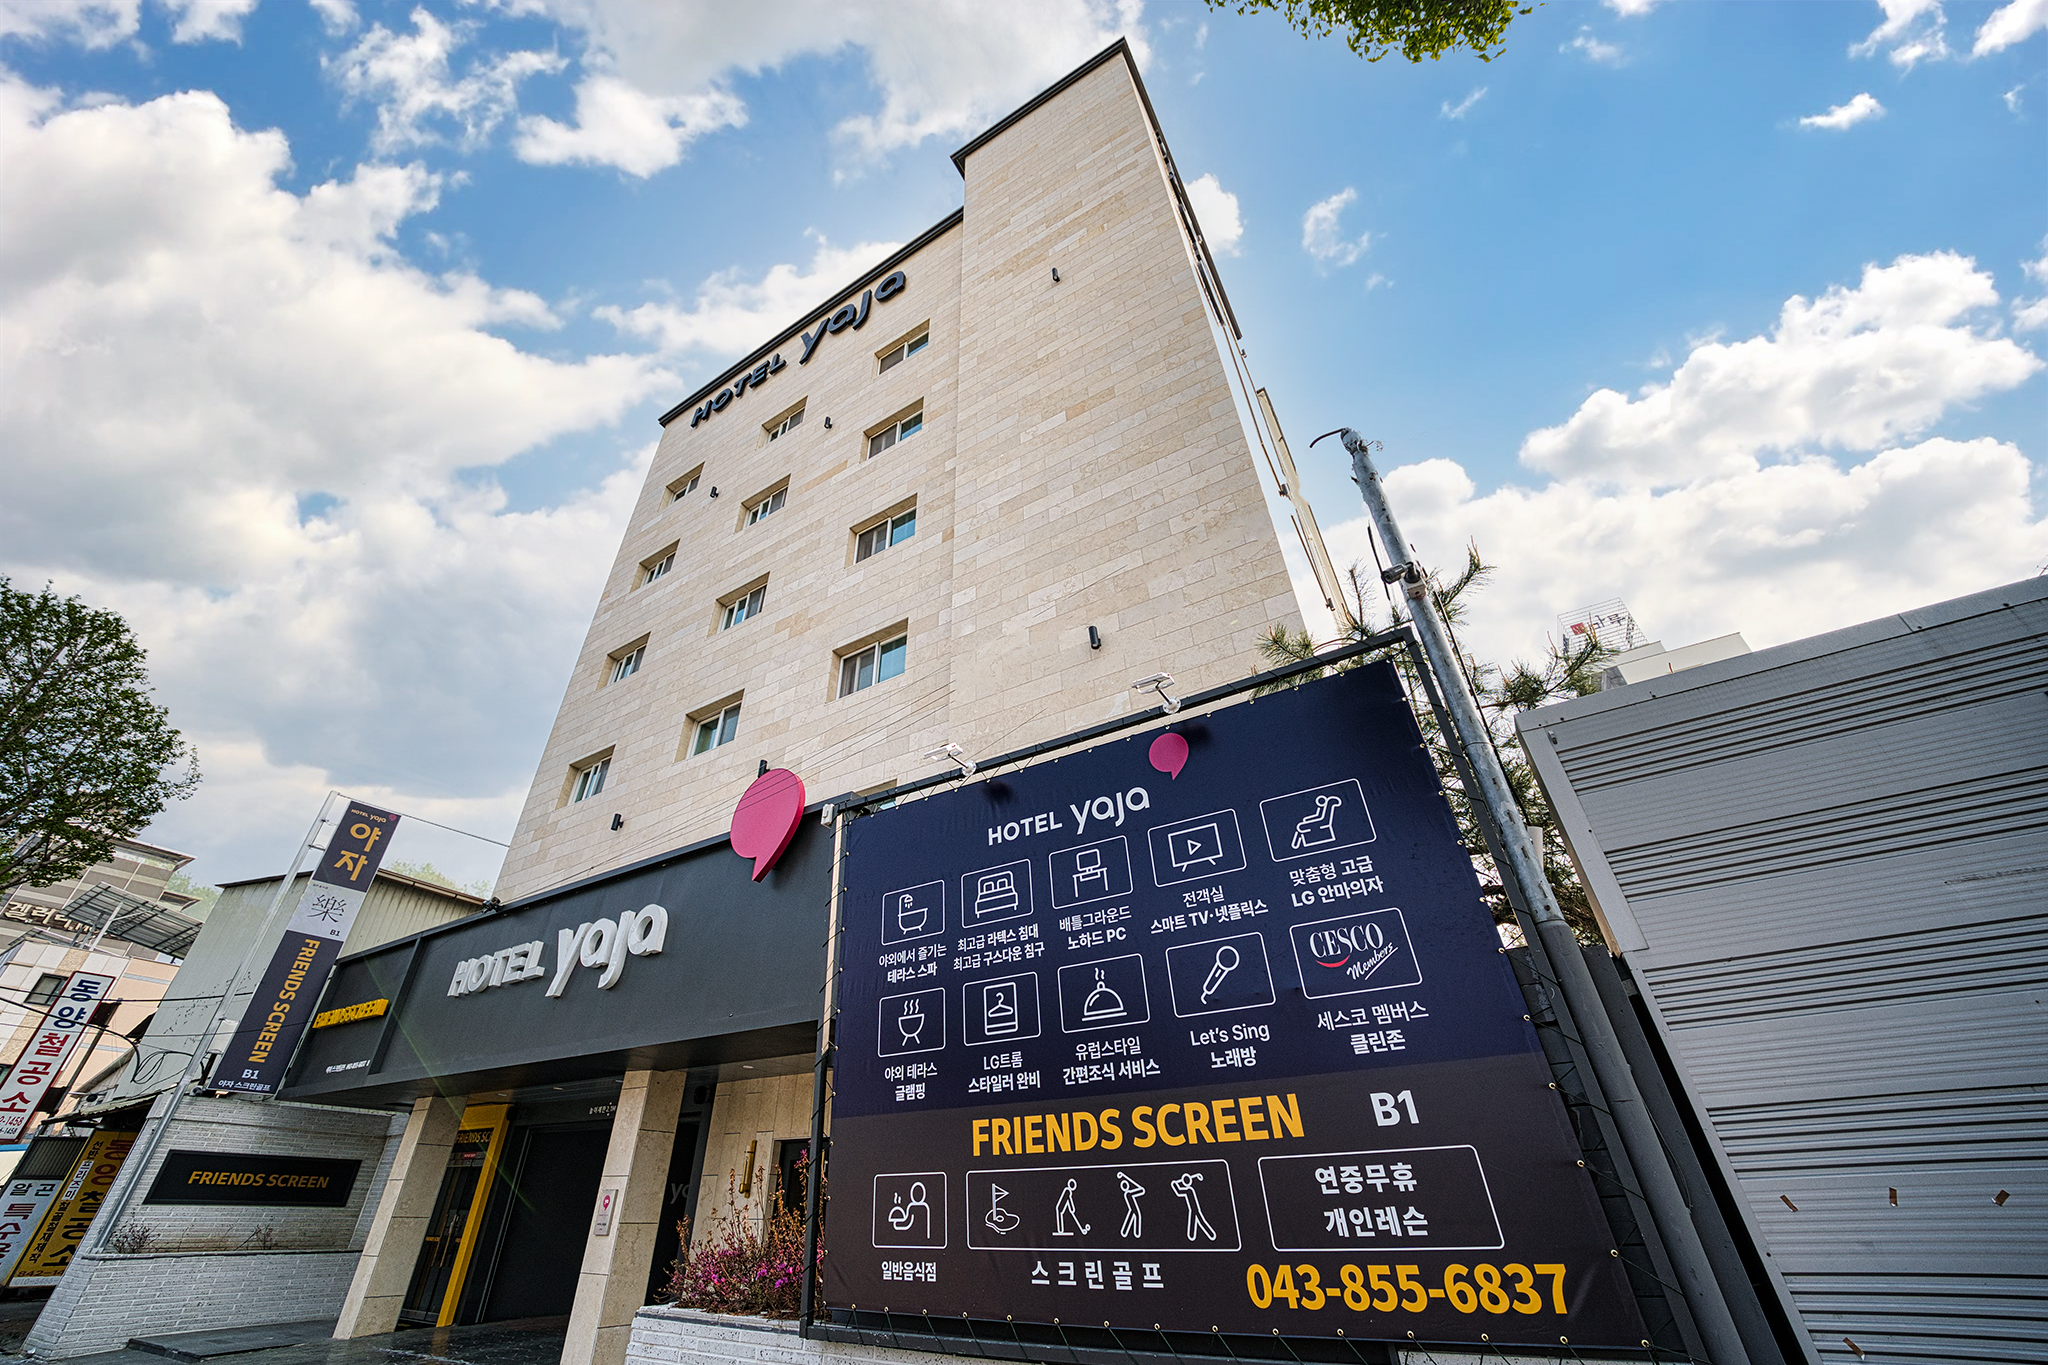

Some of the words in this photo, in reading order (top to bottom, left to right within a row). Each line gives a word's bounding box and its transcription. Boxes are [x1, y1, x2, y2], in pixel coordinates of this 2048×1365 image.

[690, 353, 787, 428] HOTEL
[799, 270, 906, 365] yaja
[351, 809, 369, 818] HOTEL
[369, 814, 387, 823] yaja
[988, 811, 1063, 845] HOTEL
[1069, 786, 1151, 834] yaja
[334, 823, 382, 881] 야자
[1289, 862, 1337, 887] 맞춤형
[1340, 855, 1373, 876] 고급
[1182, 885, 1224, 908] 전객실
[1291, 891, 1315, 908] LG
[1317, 876, 1384, 904] 안마의자
[307, 894, 347, 923] 樂
[1059, 906, 1132, 932] 배틀그라운드
[329, 929, 341, 937] B1
[957, 934, 986, 952] 최고급
[987, 929, 1017, 948] 라텍스
[1018, 923, 1039, 941] 침대
[1150, 915, 1187, 935] 스마트
[447, 940, 545, 997] HOTEL
[545, 903, 669, 998] yaja
[1067, 931, 1105, 951] 노하드
[1106, 927, 1127, 943] PC
[1309, 922, 1384, 959] CESCO
[878, 948, 916, 968] 야외에서
[917, 943, 948, 960] 즐기는
[953, 954, 981, 972] 최고급
[983, 946, 1023, 967] 구스다운
[1024, 942, 1045, 959] 침구
[1346, 941, 1397, 981] Members
[278, 938, 321, 1001] FRIENDS
[887, 965, 916, 983] 테라스
[917, 962, 938, 978] 스파
[1317, 1008, 1370, 1030] 세스코
[1372, 1000, 1429, 1022] 멤버스
[248, 1001, 291, 1063] SCREEN
[1231, 1023, 1271, 1042] Sing
[1350, 1030, 1406, 1055] 클린존
[0, 979, 102, 1113] 동양철공소
[1075, 1036, 1142, 1061] 유럽스타일
[1210, 1046, 1257, 1070] 노래방
[884, 1067, 905, 1083] 야외
[906, 1062, 938, 1080] 테라스
[983, 1051, 1024, 1070] LG트롬
[1062, 1063, 1115, 1086] 간편조식
[1118, 1058, 1161, 1079] 서비스
[218, 1079, 234, 1088] 야자
[234, 1081, 271, 1092] 스크린골프
[241, 1069, 260, 1080] B1
[968, 1073, 1014, 1094] 스타일러
[1016, 1070, 1041, 1089] 완비
[895, 1083, 926, 1101] 글램핑
[1369, 1090, 1420, 1127] B1
[455, 1131, 482, 1144] FRIENDS
[972, 1108, 1124, 1156] FRIENDS
[1131, 1093, 1305, 1148] SCREEN
[188, 1171, 266, 1187] FRIENDS
[266, 1174, 330, 1189] SCREEN
[1314, 1162, 1417, 1195] 연중무휴
[1324, 1206, 1430, 1237] 개인레슨
[881, 1261, 937, 1282] 일반음식점
[1246, 1263, 1568, 1314] 043-855-6837
